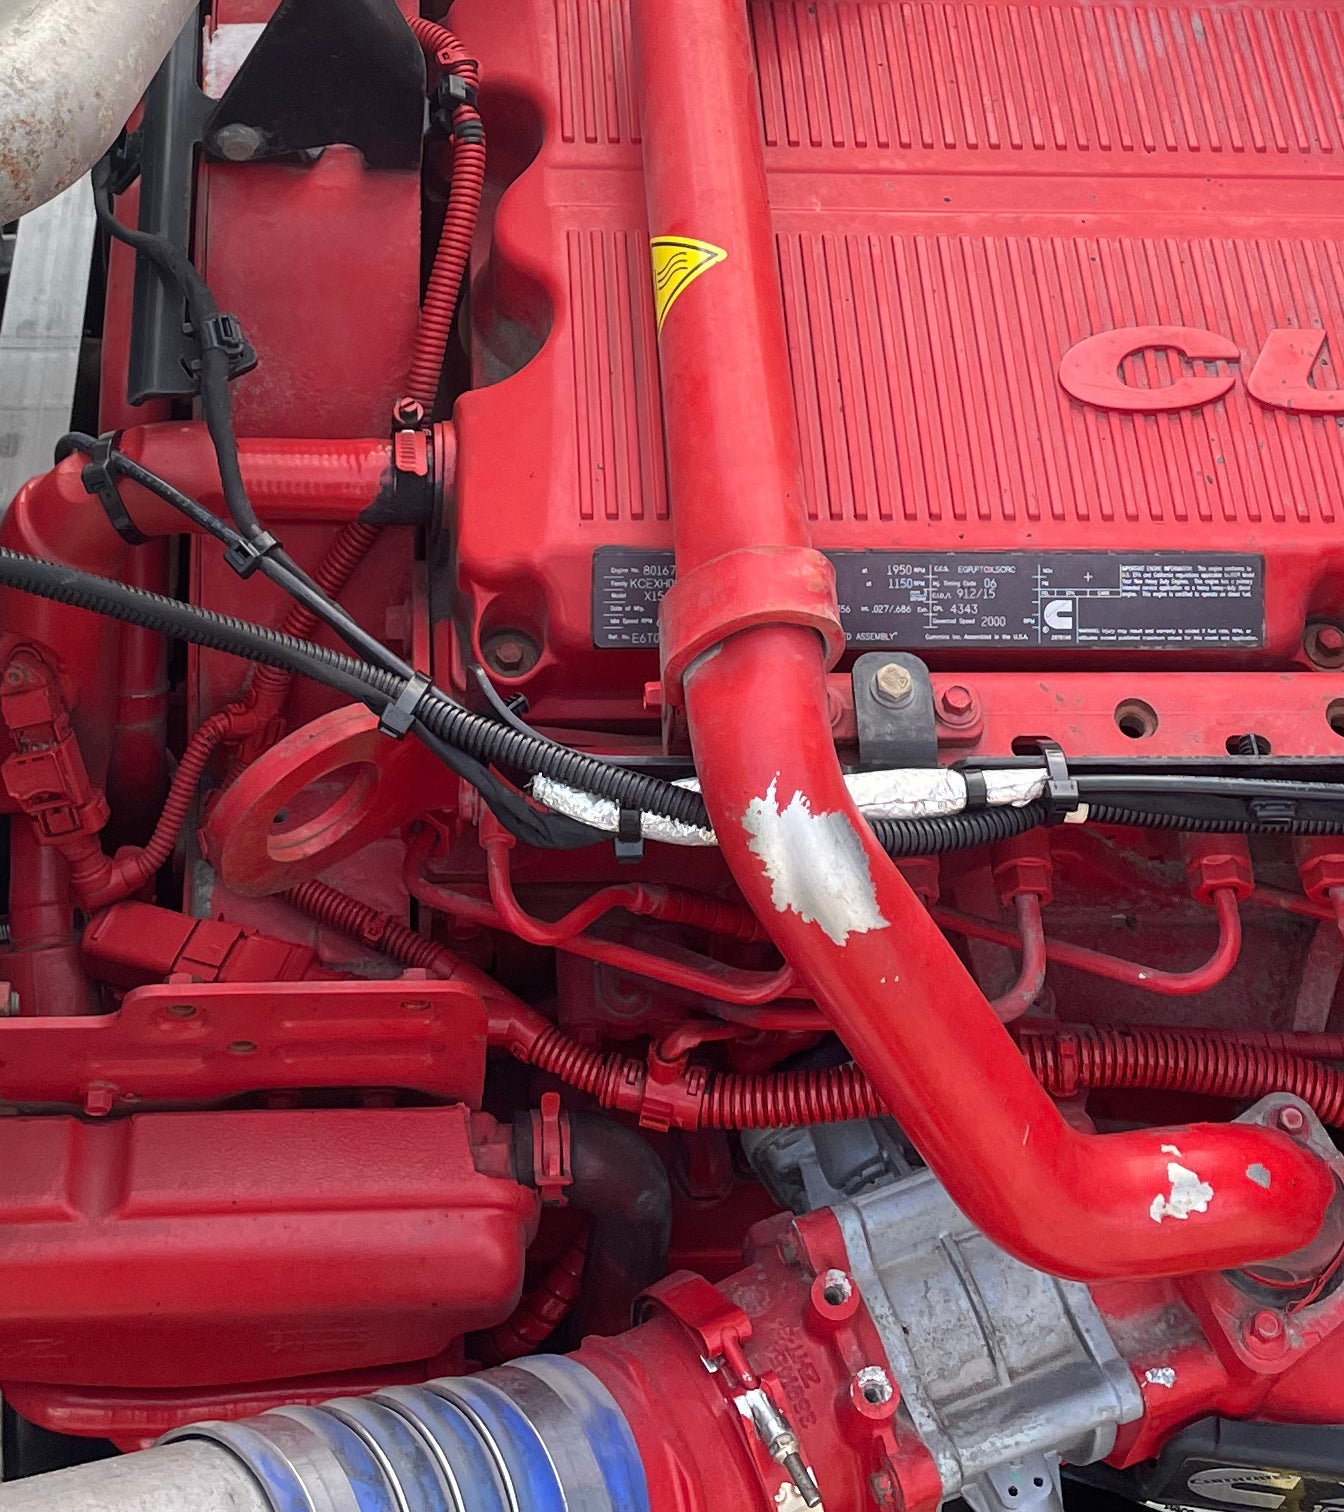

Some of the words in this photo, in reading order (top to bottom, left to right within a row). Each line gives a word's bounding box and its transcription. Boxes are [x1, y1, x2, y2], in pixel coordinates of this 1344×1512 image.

[886, 564, 912, 576] 1950
[888, 578, 913, 589] 1150
[983, 577, 998, 589] 06
[956, 588, 996, 600] 912/15
[949, 604, 978, 615] 4343
[980, 616, 1007, 627] 2000
